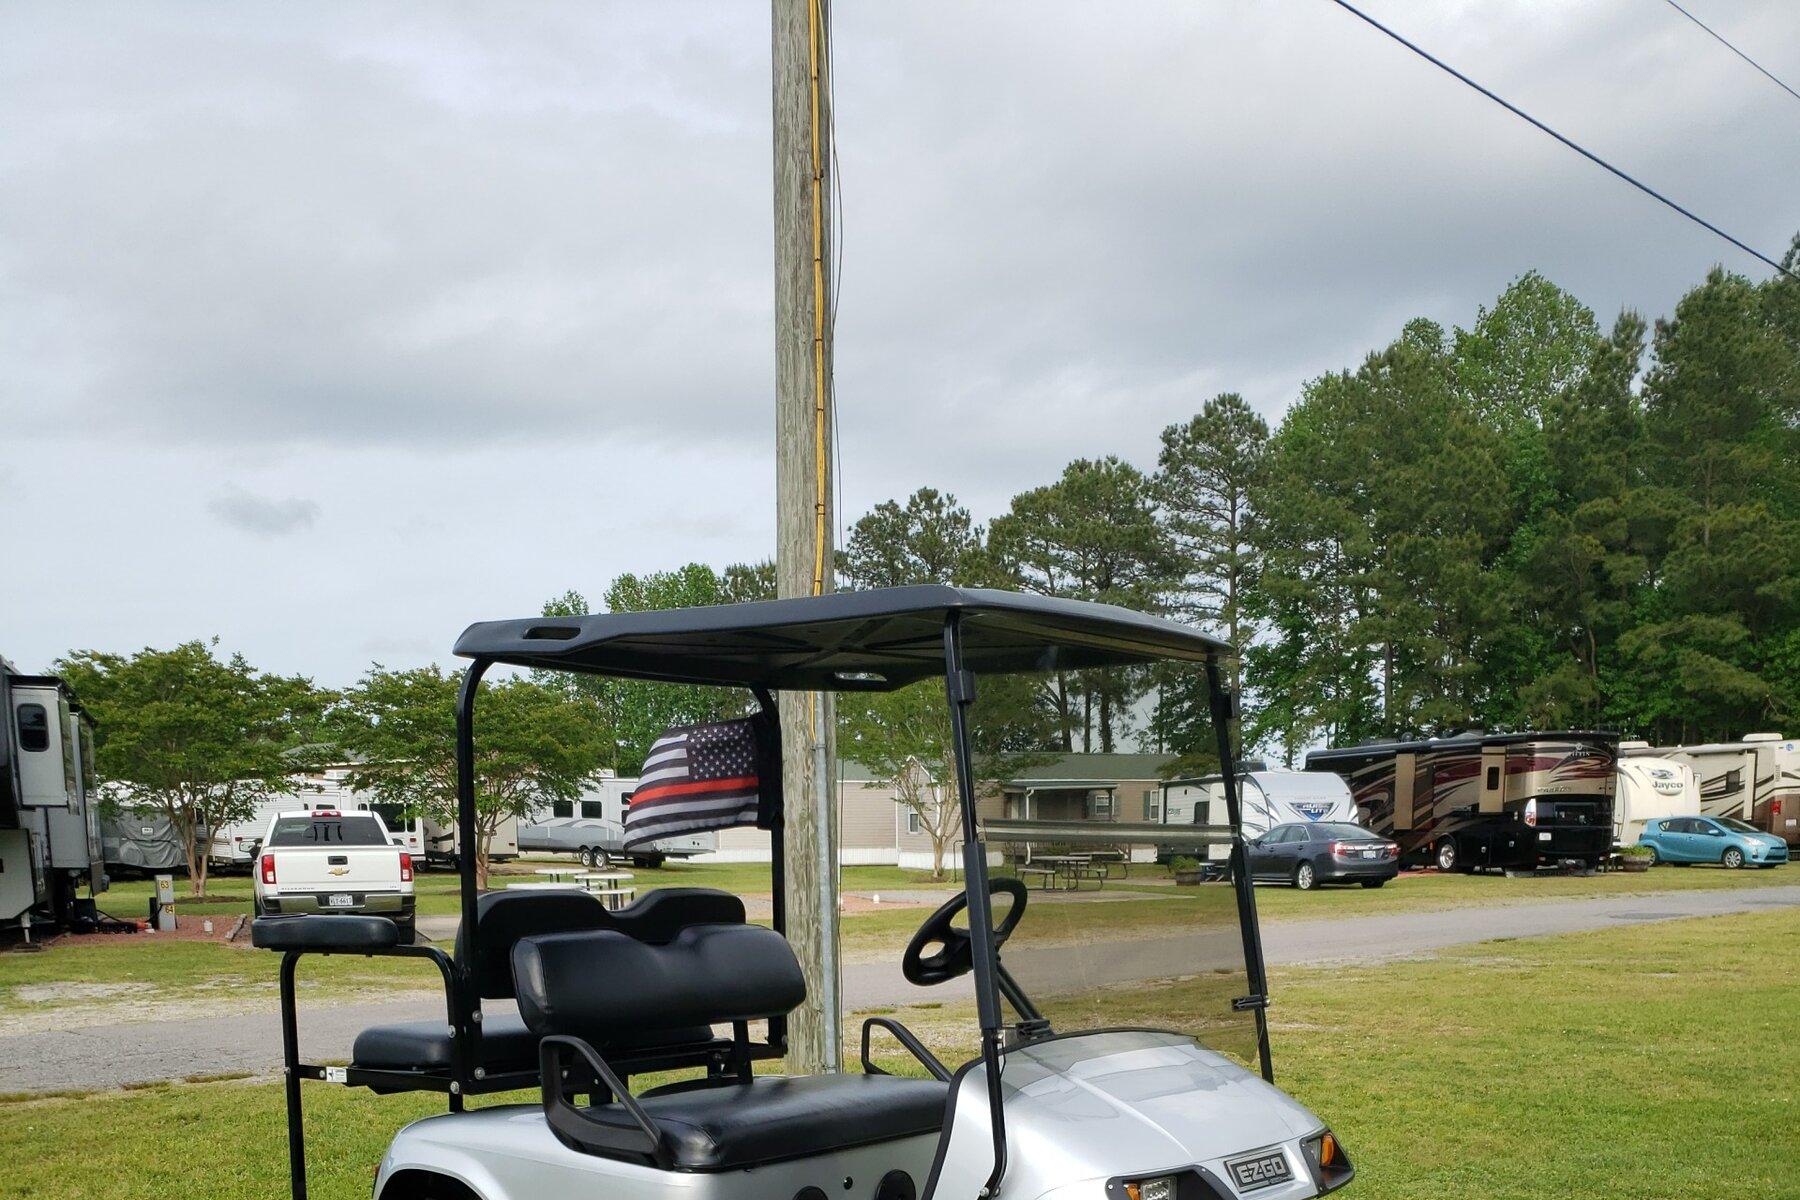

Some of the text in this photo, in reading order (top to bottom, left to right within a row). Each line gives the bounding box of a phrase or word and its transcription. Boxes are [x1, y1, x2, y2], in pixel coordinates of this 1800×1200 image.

[1652, 781, 1683, 790] Jayco
[160, 880, 169, 889] 63
[165, 905, 174, 914] 64
[1236, 1156, 1287, 1184] EZGO
